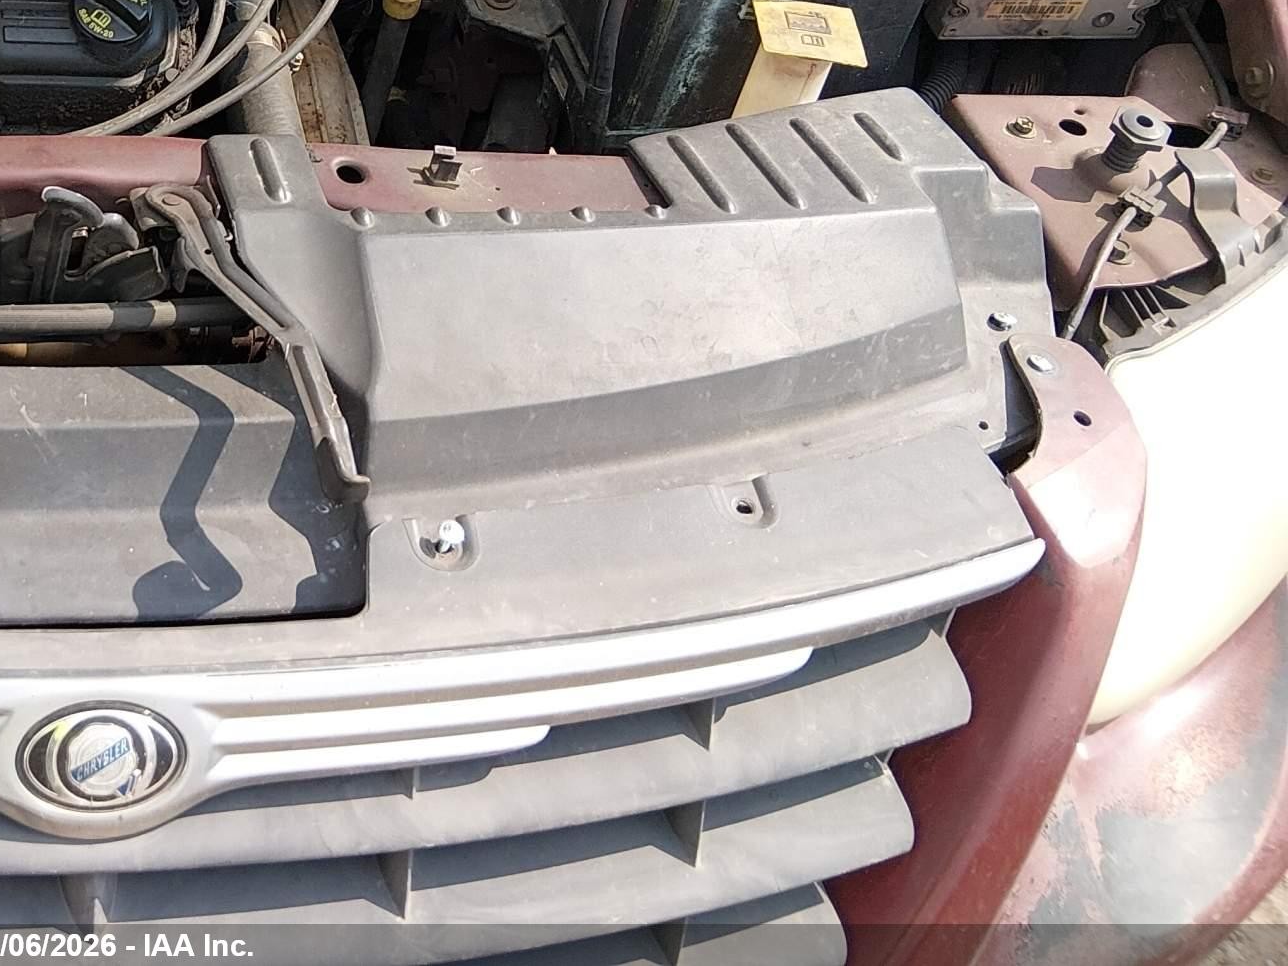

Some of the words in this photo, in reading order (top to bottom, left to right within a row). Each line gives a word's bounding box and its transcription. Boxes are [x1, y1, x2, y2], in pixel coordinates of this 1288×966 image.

[78, 8, 92, 24] SAE
[88, 21, 114, 38] 5W-20
[76, 737, 129, 781] CHRYSLER
